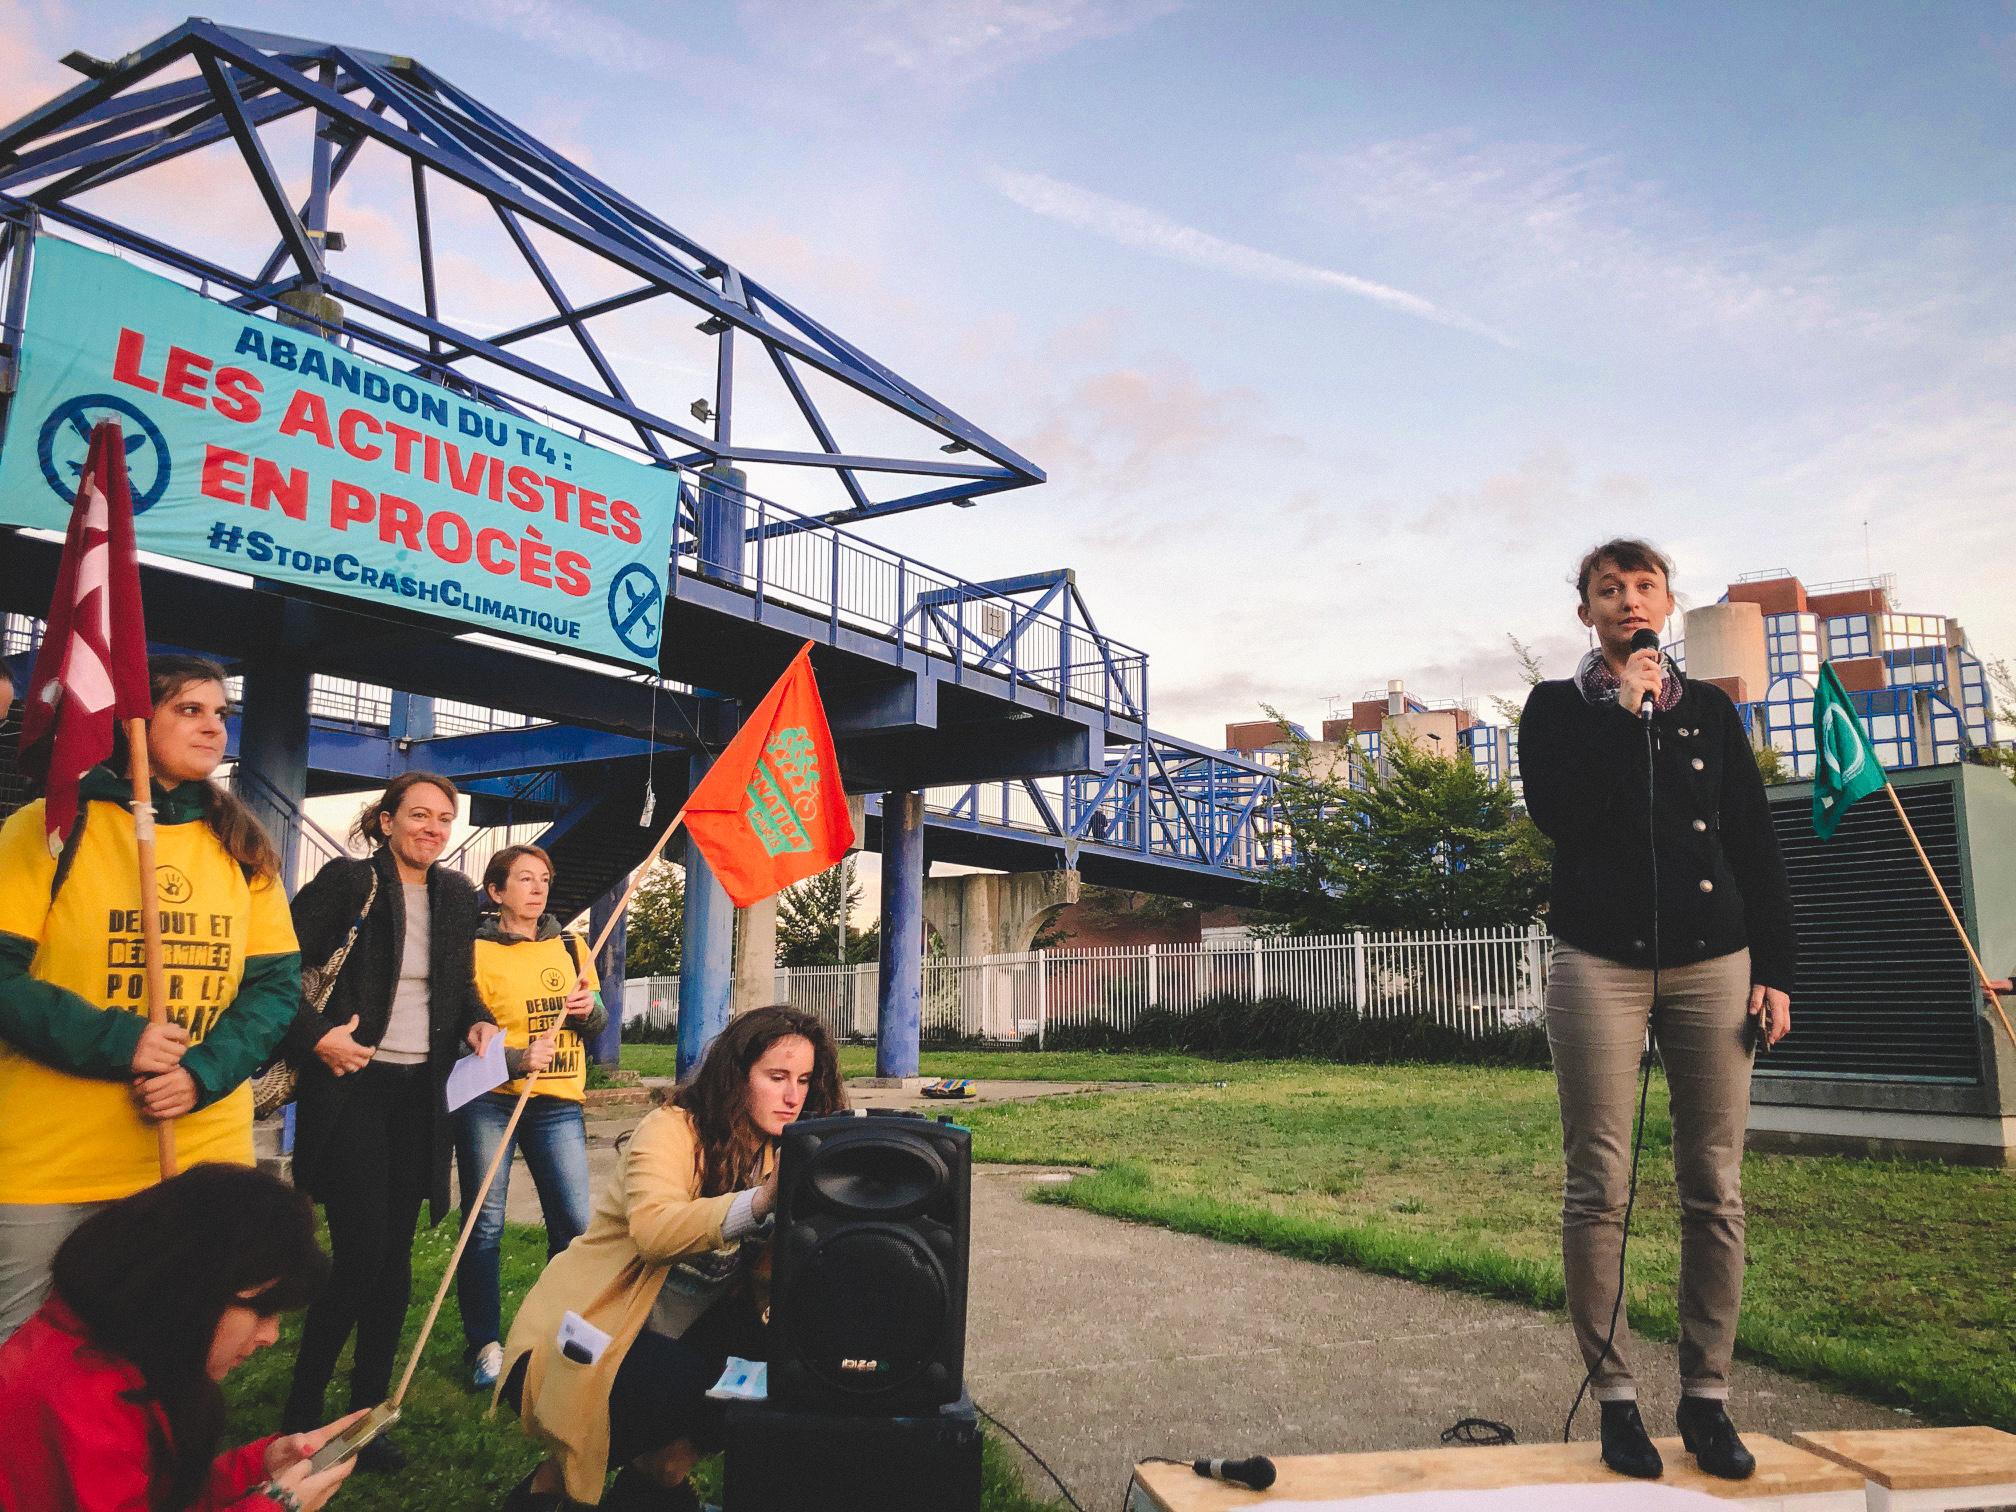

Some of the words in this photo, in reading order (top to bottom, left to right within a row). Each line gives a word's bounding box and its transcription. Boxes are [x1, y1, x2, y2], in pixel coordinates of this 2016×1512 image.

[113, 327, 264, 424] LES
[279, 389, 642, 545] ACTIVISTES
[235, 326, 449, 428] ABANDON
[458, 406, 508, 447] DU
[516, 428, 557, 466] T4
[200, 443, 309, 521] EN
[330, 479, 592, 597] PROCÈS
[107, 973, 184, 1000] POR
[108, 909, 198, 936] DEOUT
[209, 914, 233, 938] ET
